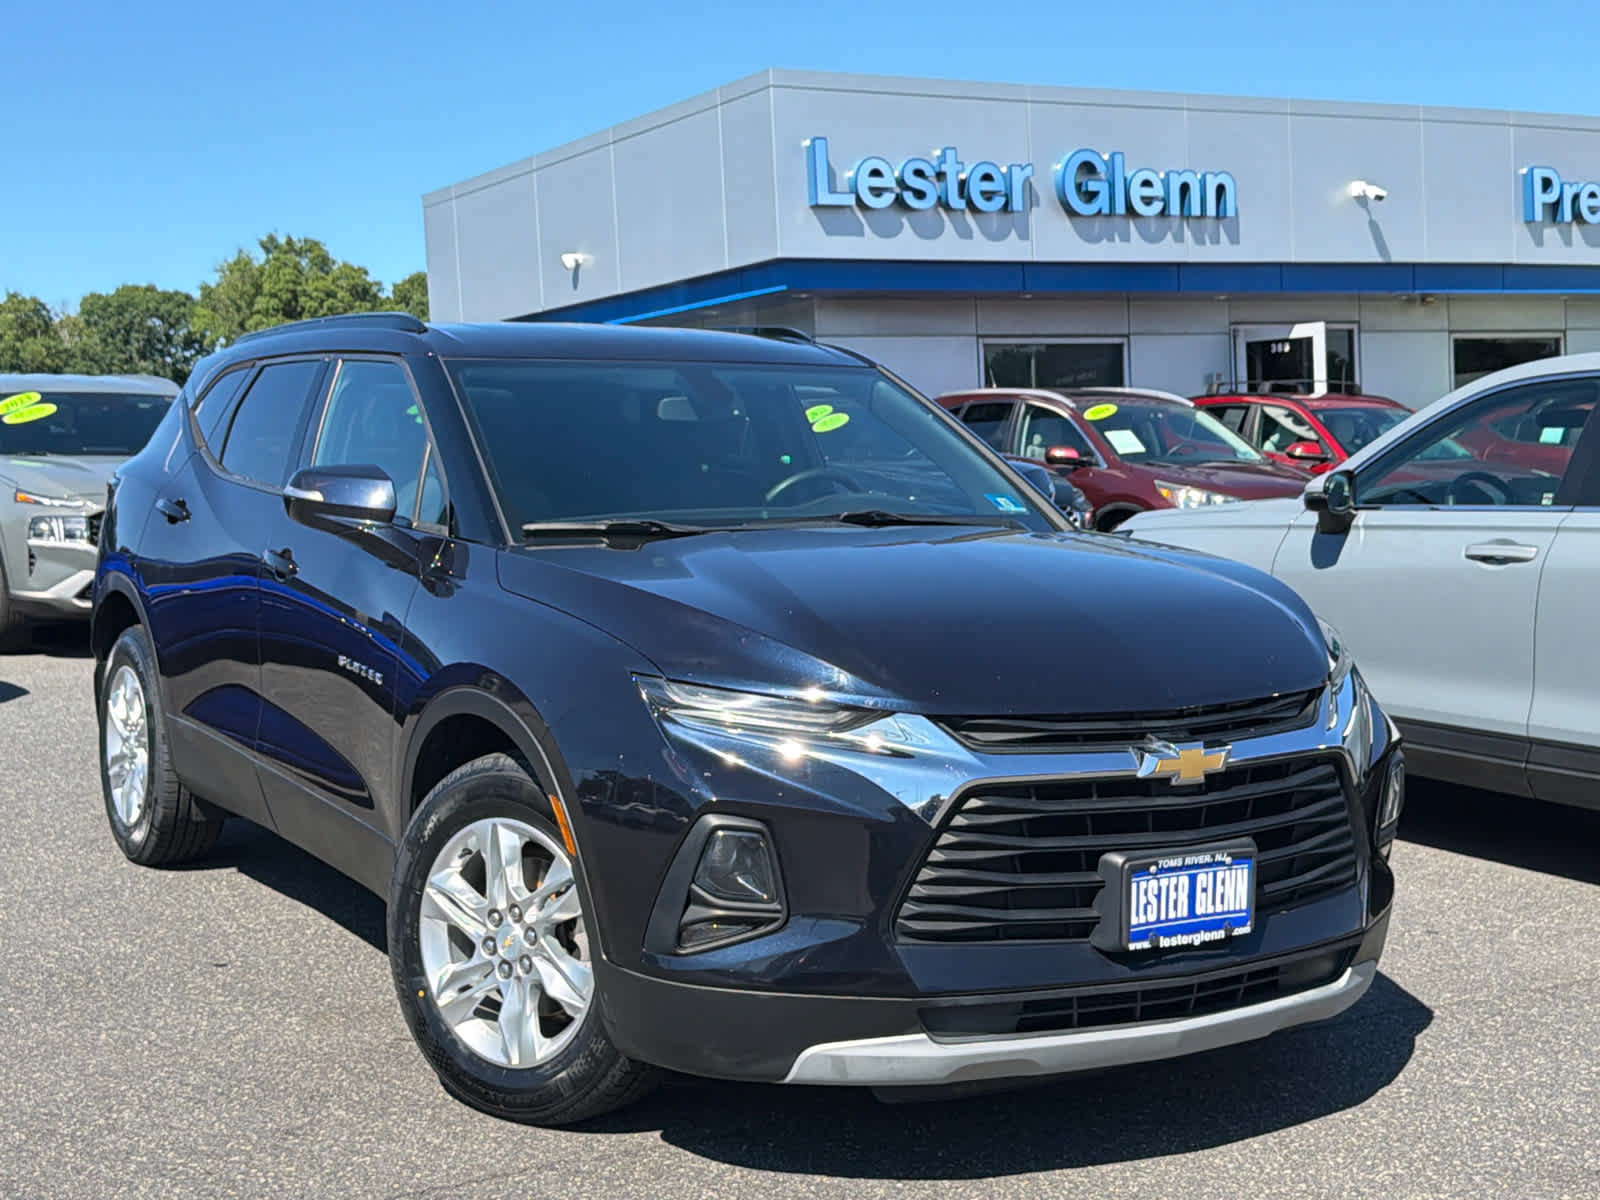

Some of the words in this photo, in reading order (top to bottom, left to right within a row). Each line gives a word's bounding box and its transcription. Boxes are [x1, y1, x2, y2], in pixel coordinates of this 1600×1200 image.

[806, 137, 1033, 213] Lester
[1055, 148, 1237, 216] Glenn
[1158, 856, 1183, 869] TOMS
[1130, 874, 1189, 925] LESTER
[1195, 868, 1249, 916] GLENN
